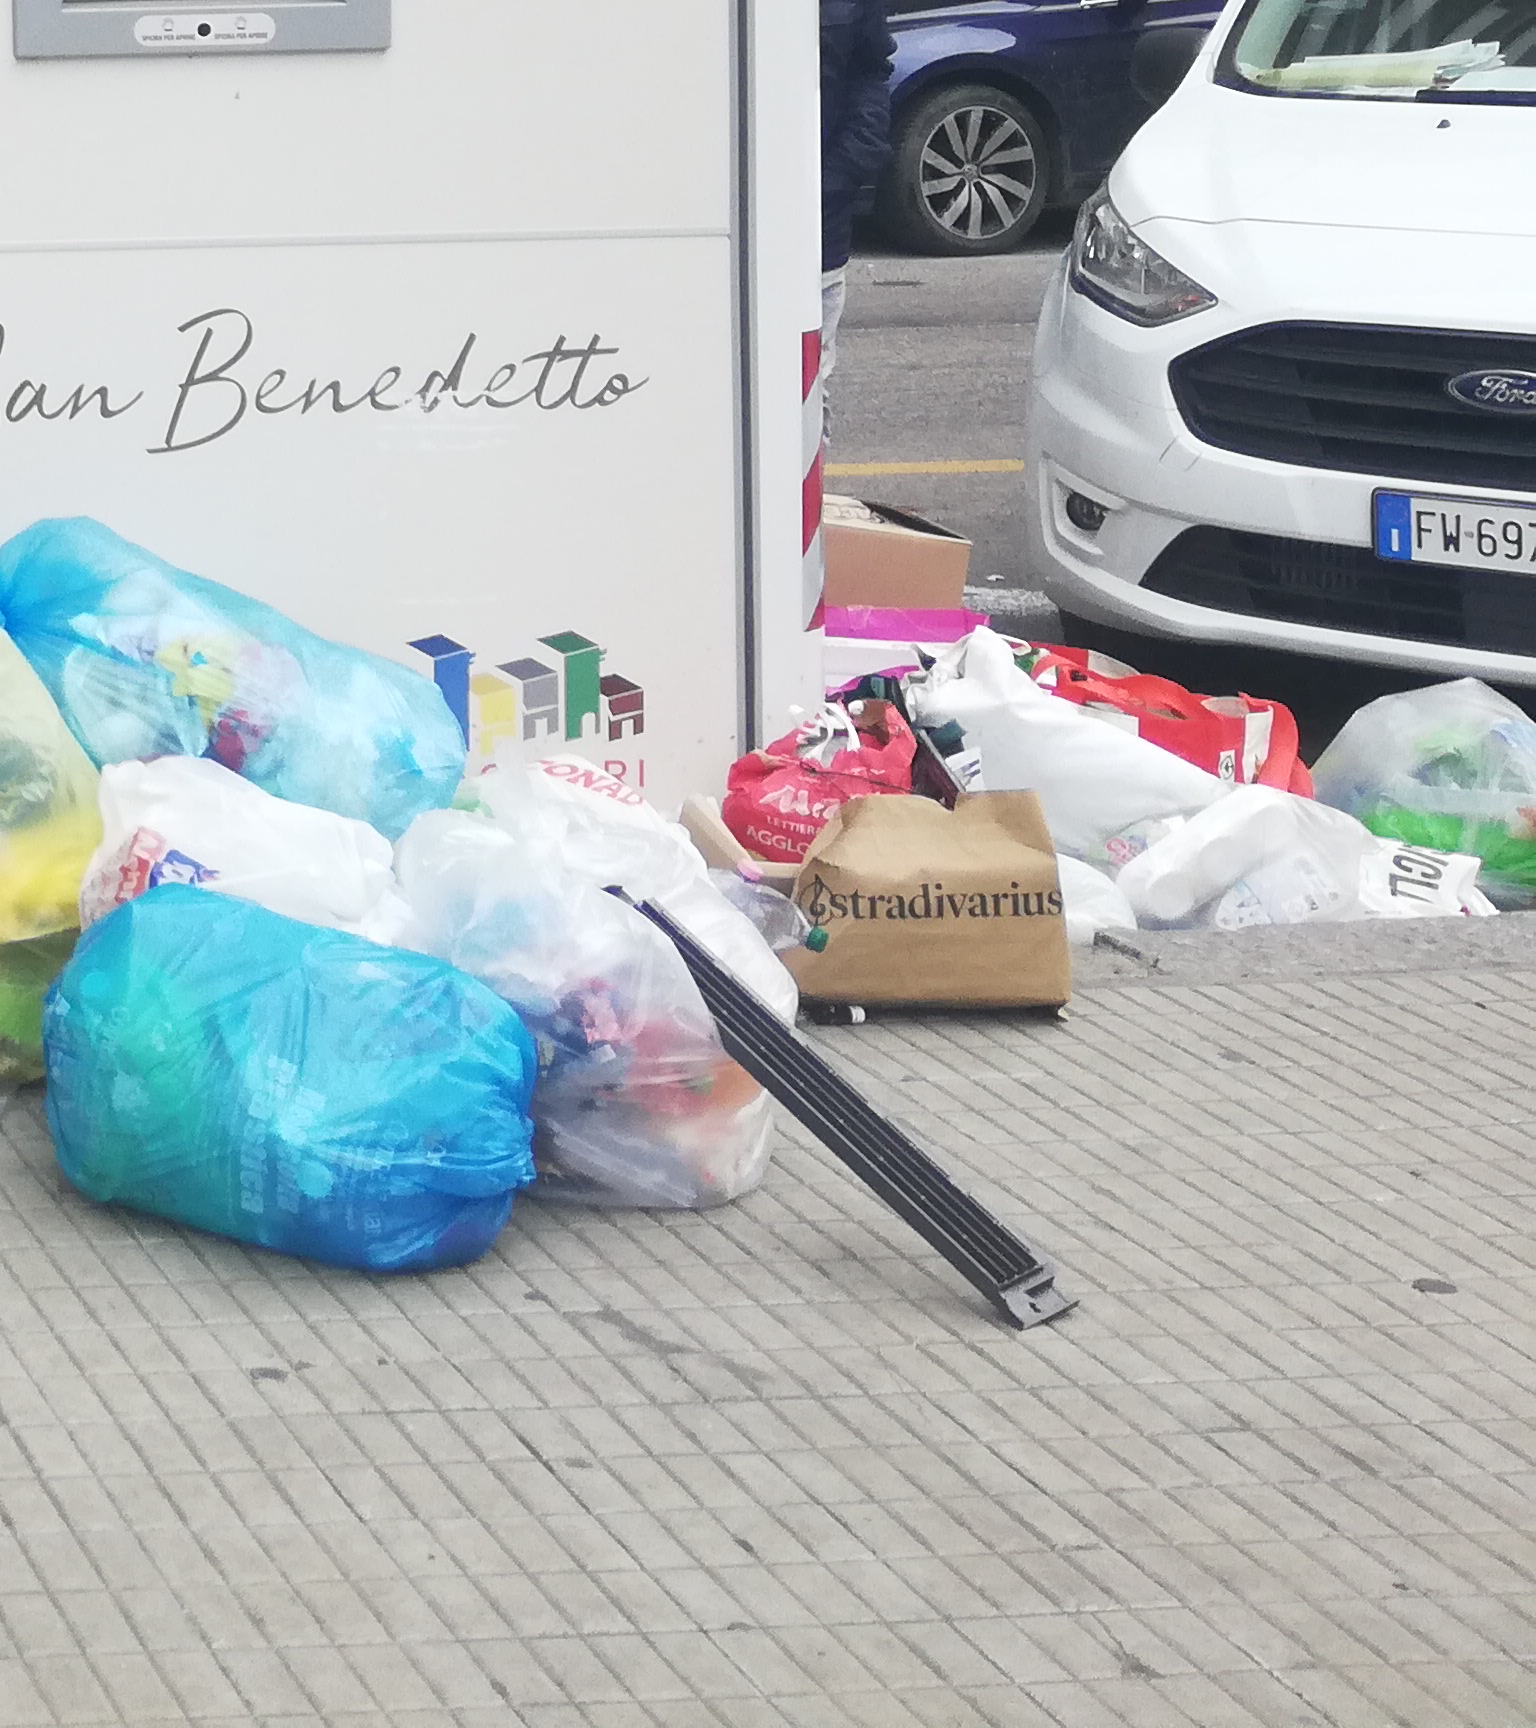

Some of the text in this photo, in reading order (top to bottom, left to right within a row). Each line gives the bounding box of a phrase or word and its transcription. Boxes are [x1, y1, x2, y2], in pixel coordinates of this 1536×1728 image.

[145, 308, 651, 454] Benedetto
[1416, 510, 1461, 553] FW
[536, 759, 645, 806] ONAD
[828, 881, 1064, 922] stradivarius
